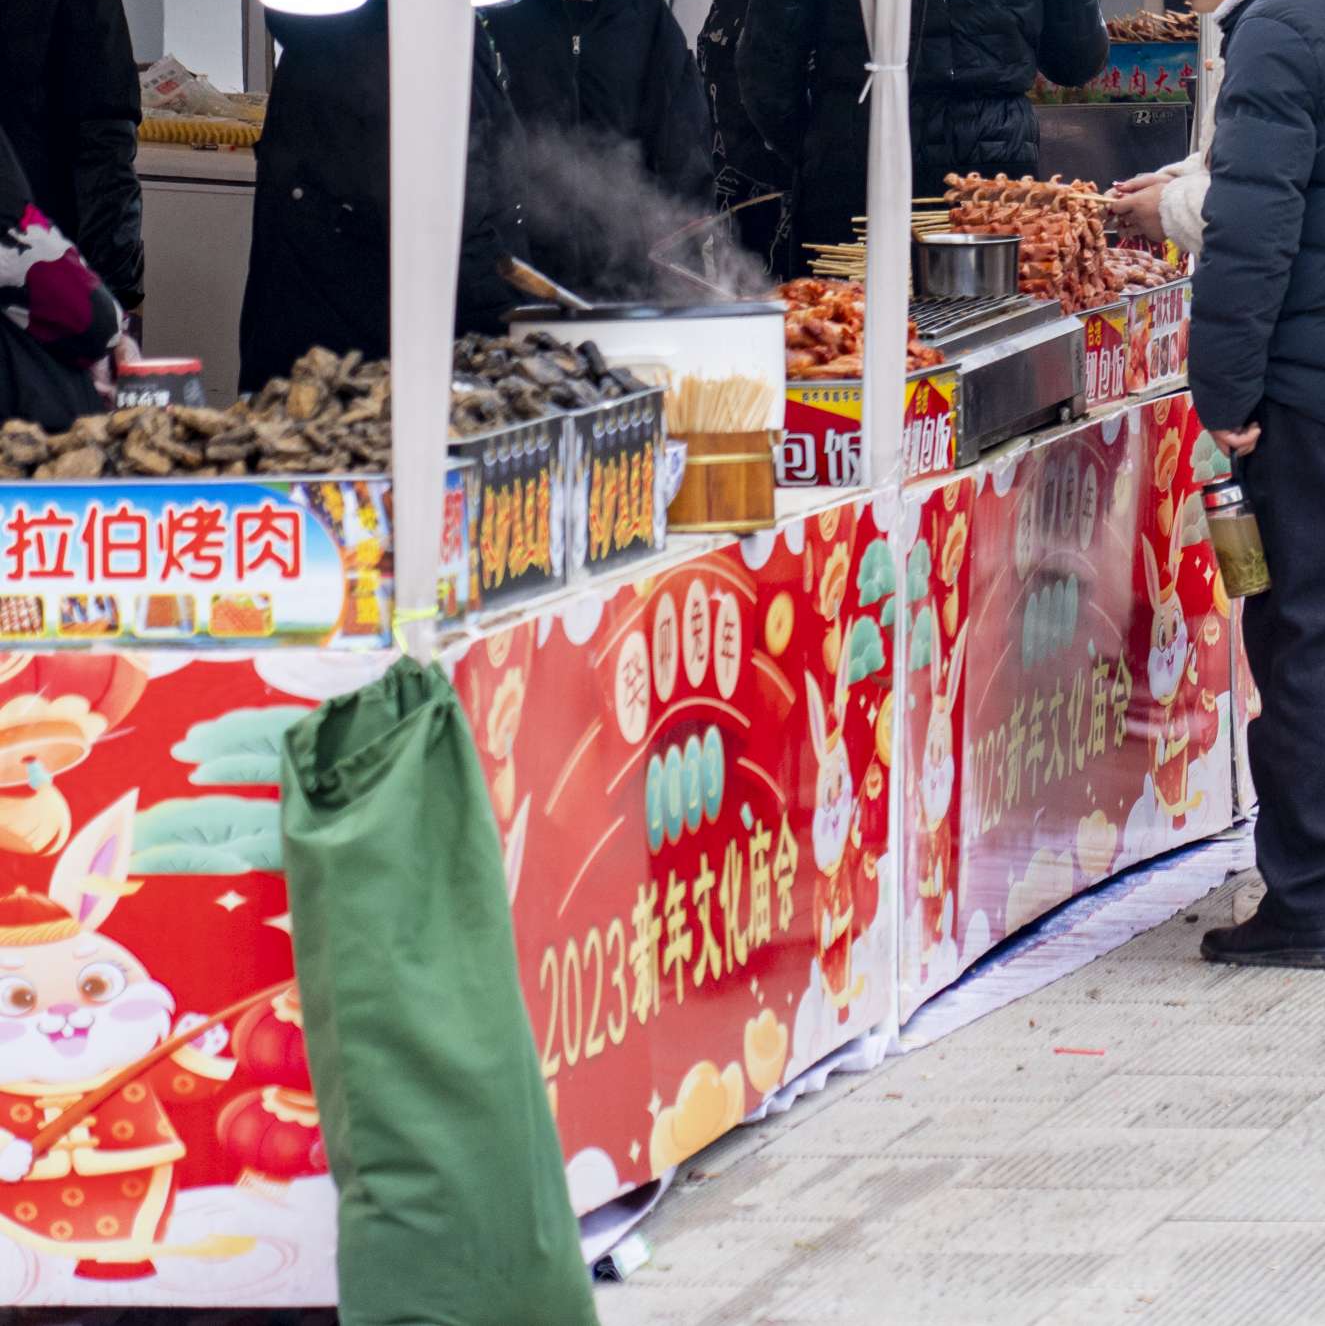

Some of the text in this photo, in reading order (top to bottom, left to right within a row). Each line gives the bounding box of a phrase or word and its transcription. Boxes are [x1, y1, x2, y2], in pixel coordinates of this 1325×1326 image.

[8, 505, 302, 581] 拉伯烤肉
[622, 600, 737, 727] 癸卯兔年
[539, 810, 799, 1080] 2023新年文化庙会
